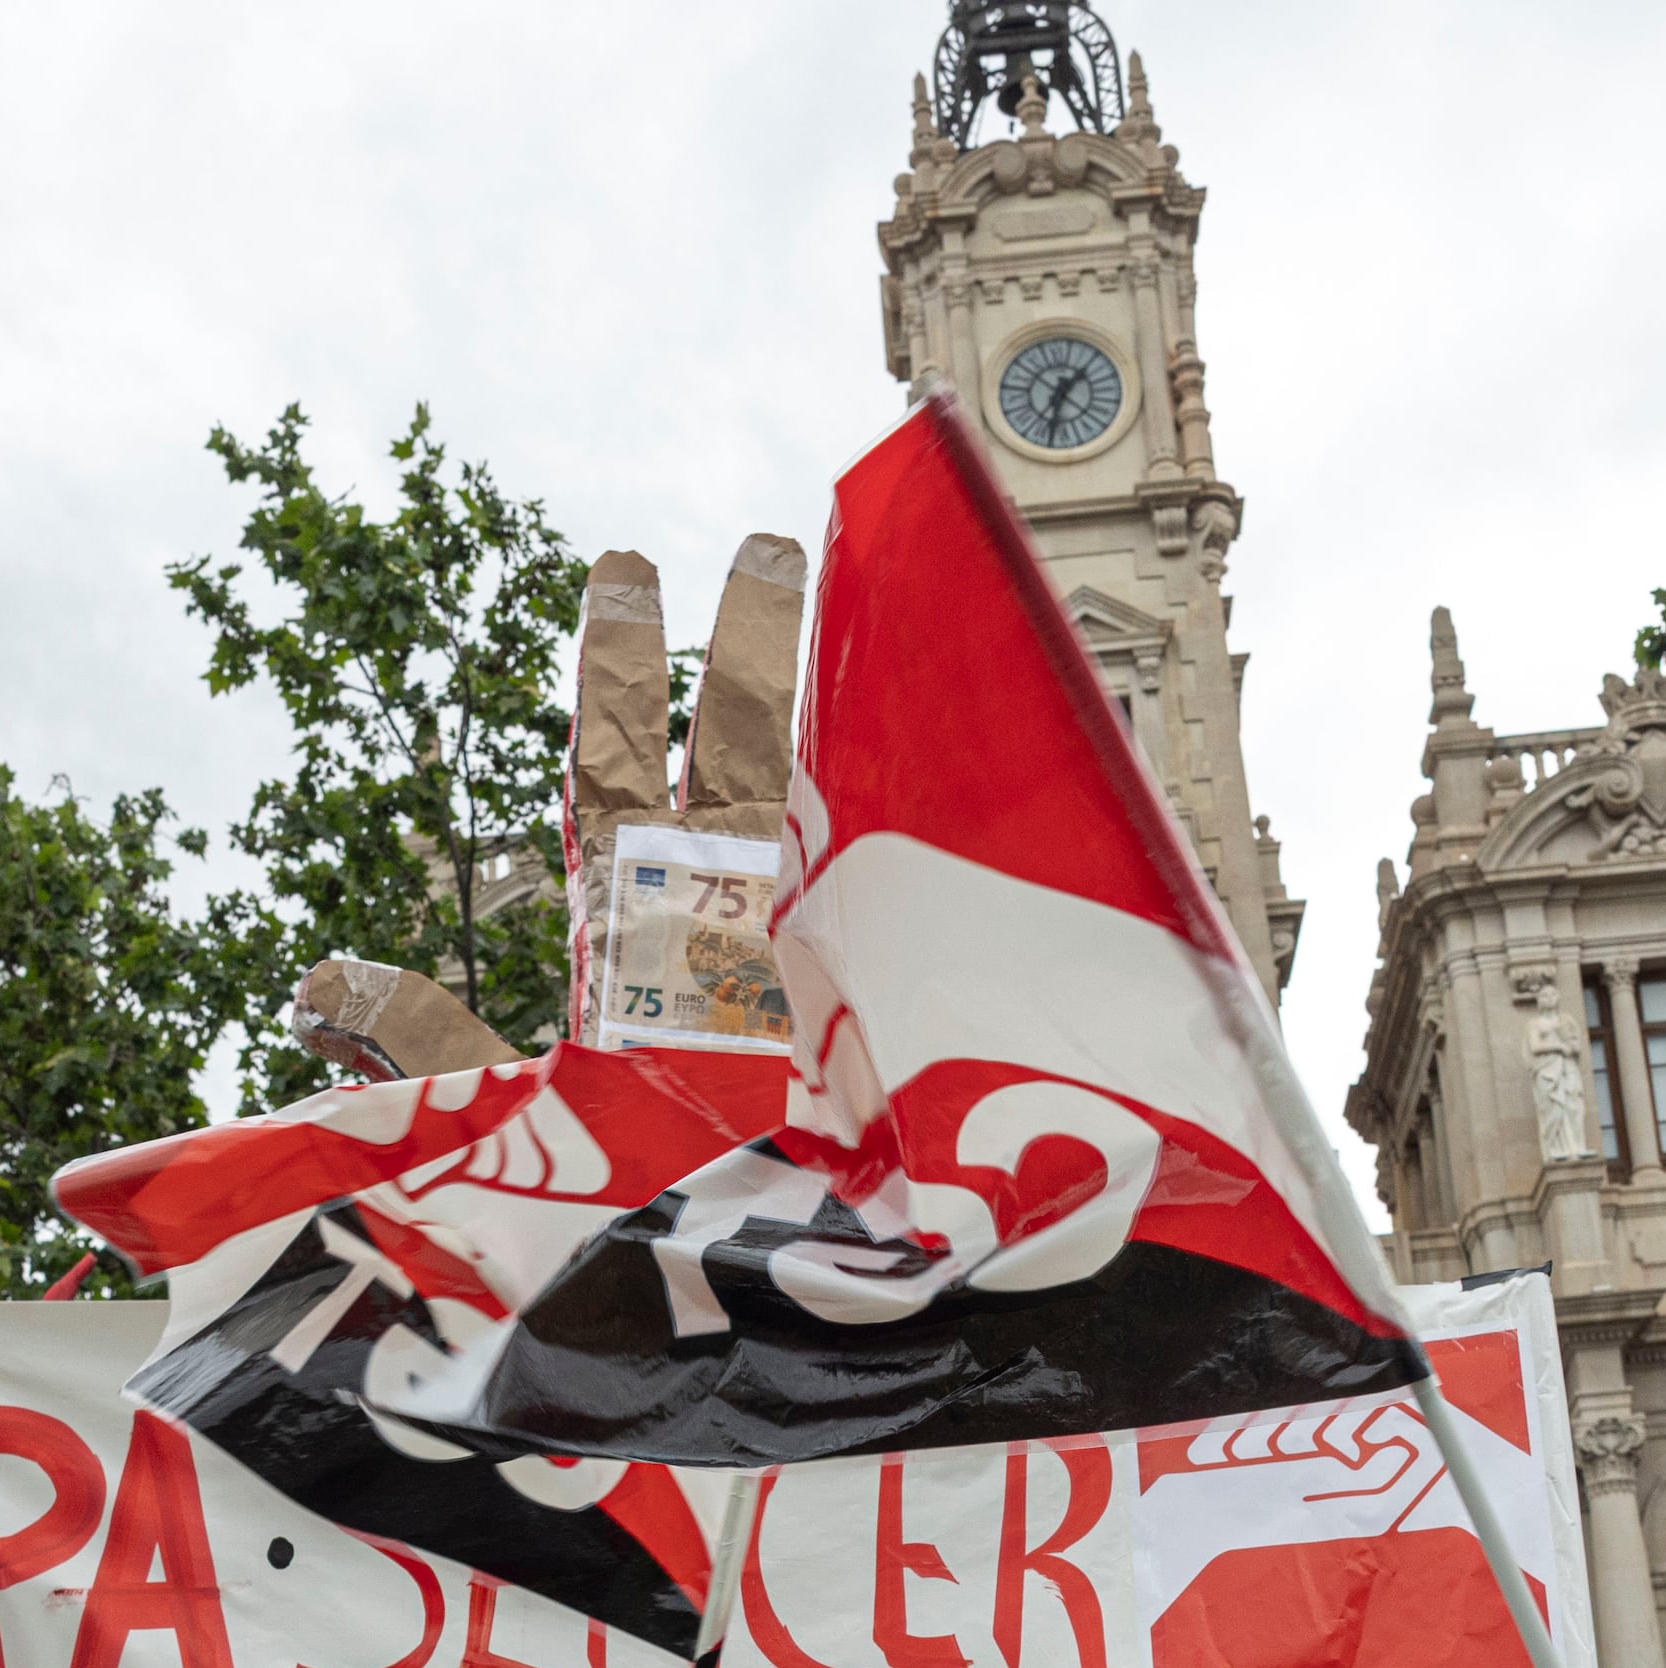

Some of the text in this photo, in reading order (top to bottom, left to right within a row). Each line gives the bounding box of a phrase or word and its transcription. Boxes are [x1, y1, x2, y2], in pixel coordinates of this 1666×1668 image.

[690, 872, 748, 920] 75
[624, 985, 663, 1018] 75
[674, 993, 706, 1005] EURO
